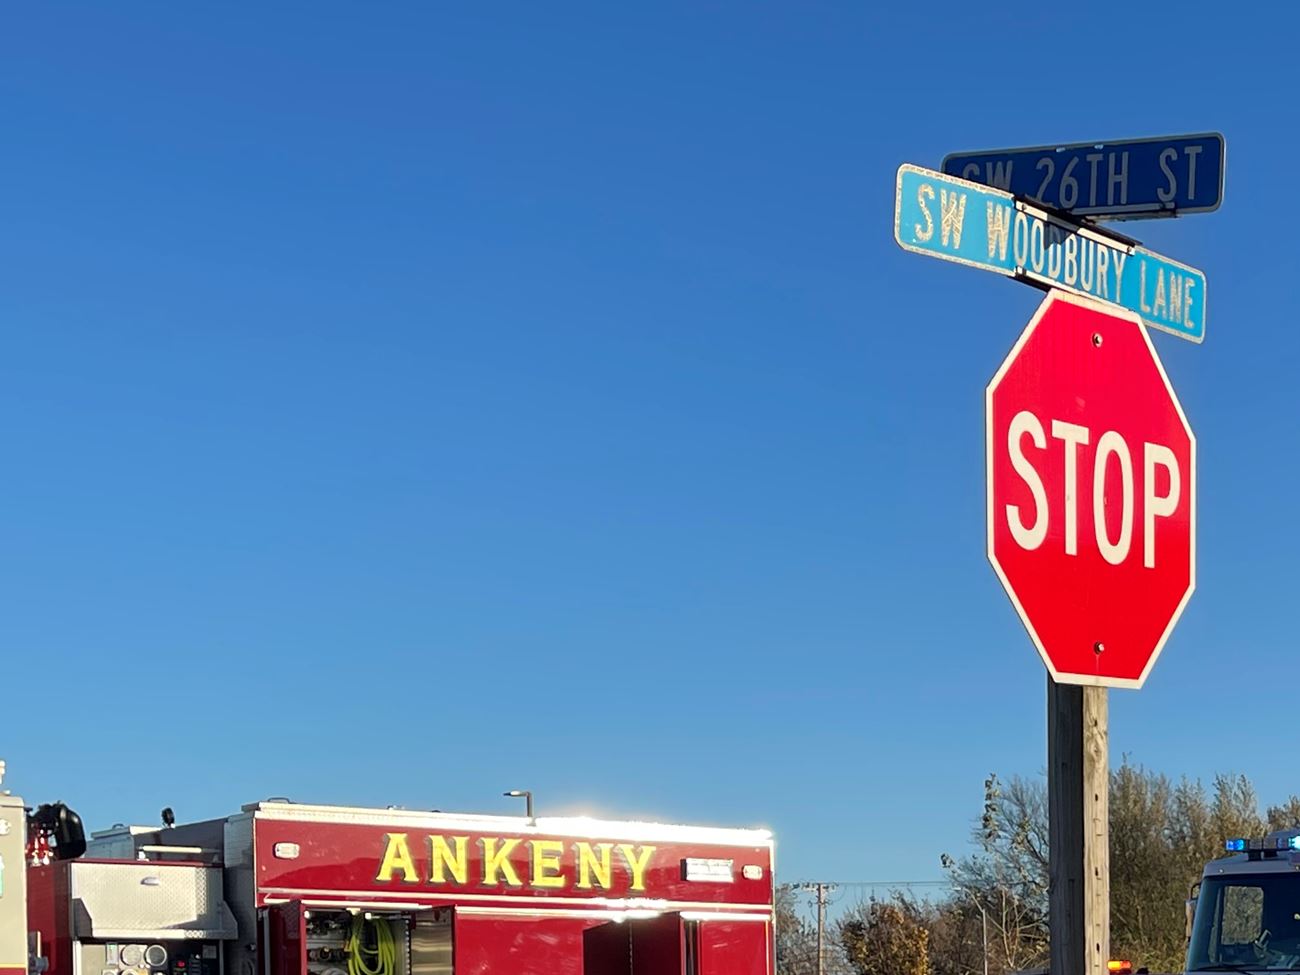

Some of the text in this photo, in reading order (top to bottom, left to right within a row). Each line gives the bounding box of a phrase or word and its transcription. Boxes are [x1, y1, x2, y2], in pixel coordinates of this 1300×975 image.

[1035, 151, 1129, 208] 26TH
[1157, 146, 1202, 201] ST
[915, 184, 1196, 329] SW WOODBURY LANE
[1006, 410, 1181, 569] STOP
[375, 832, 657, 891] ANKENY
